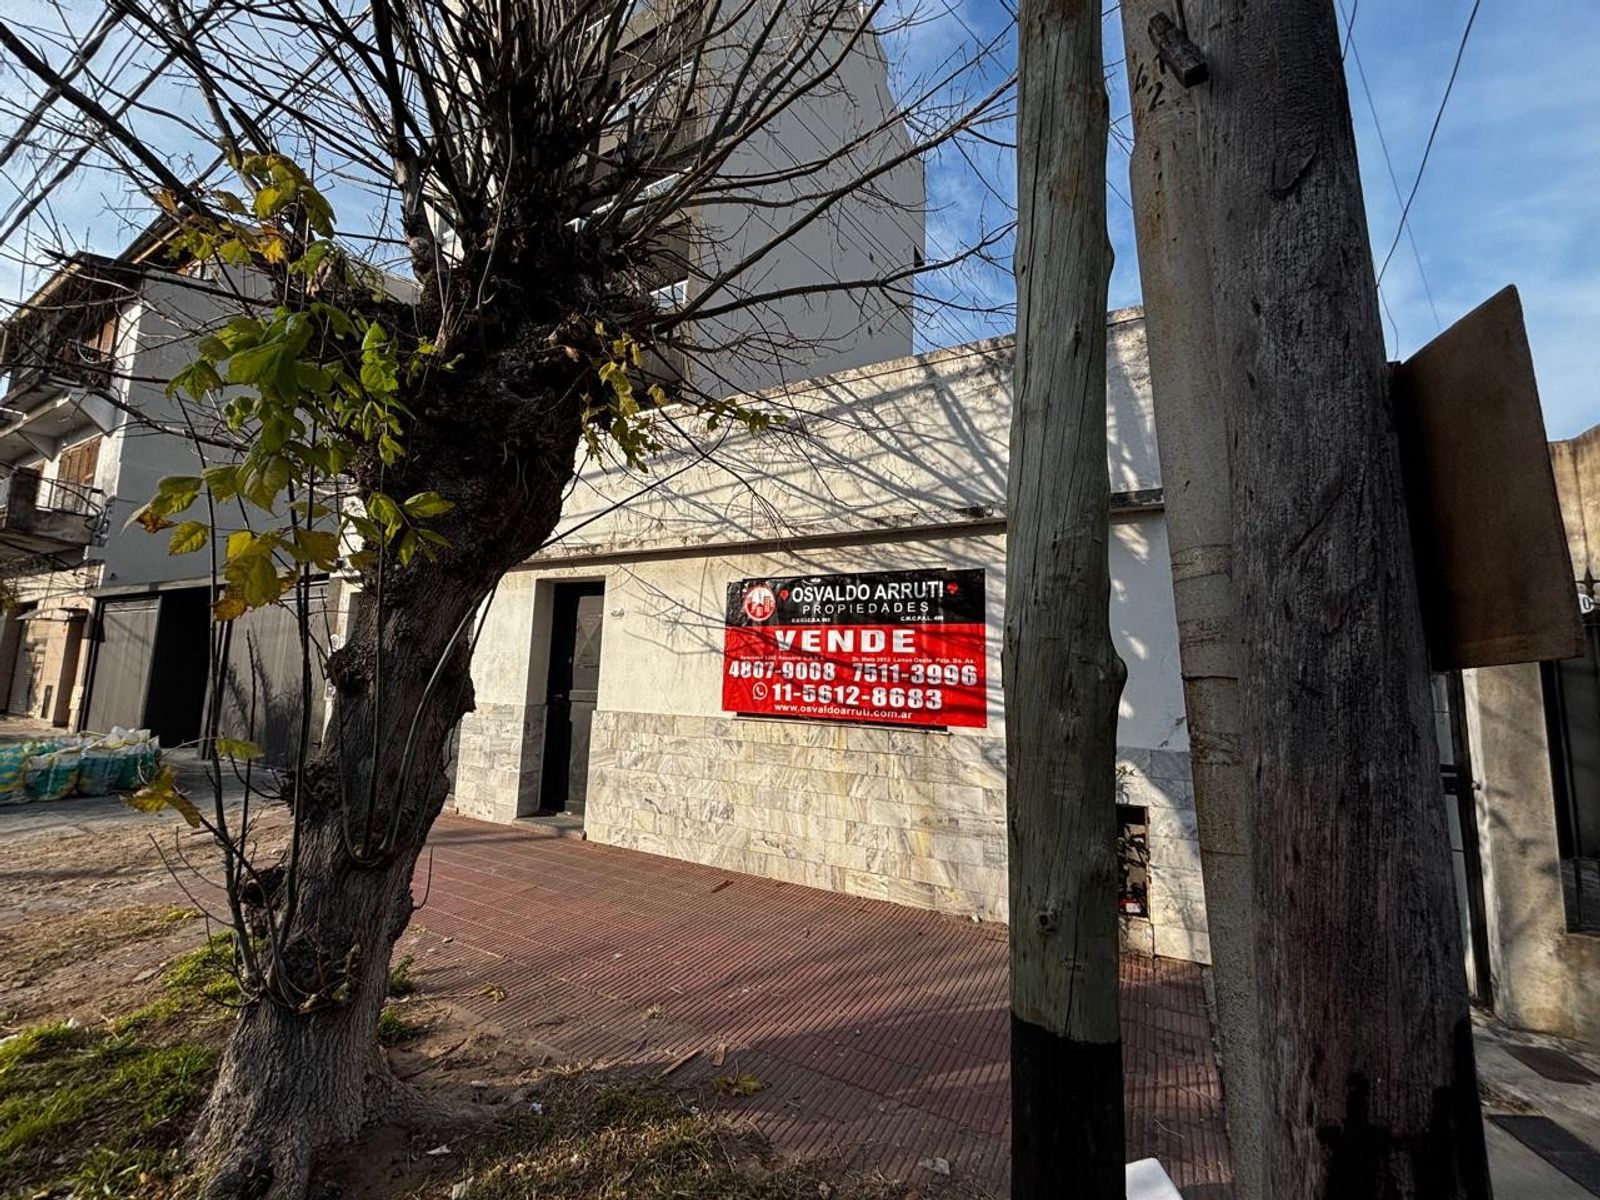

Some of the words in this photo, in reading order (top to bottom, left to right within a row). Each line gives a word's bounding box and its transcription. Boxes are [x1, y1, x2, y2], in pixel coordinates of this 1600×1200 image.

[792, 583, 870, 602] OSVALDO
[874, 580, 944, 600] ARRUTI
[802, 602, 929, 615] PROPIEDADES
[775, 629, 916, 653] VENDE
[852, 663, 978, 686] 7511-3996
[772, 683, 942, 710] 11-5612-8683
[773, 703, 913, 719] www.osvaldoarruti.com.ar
